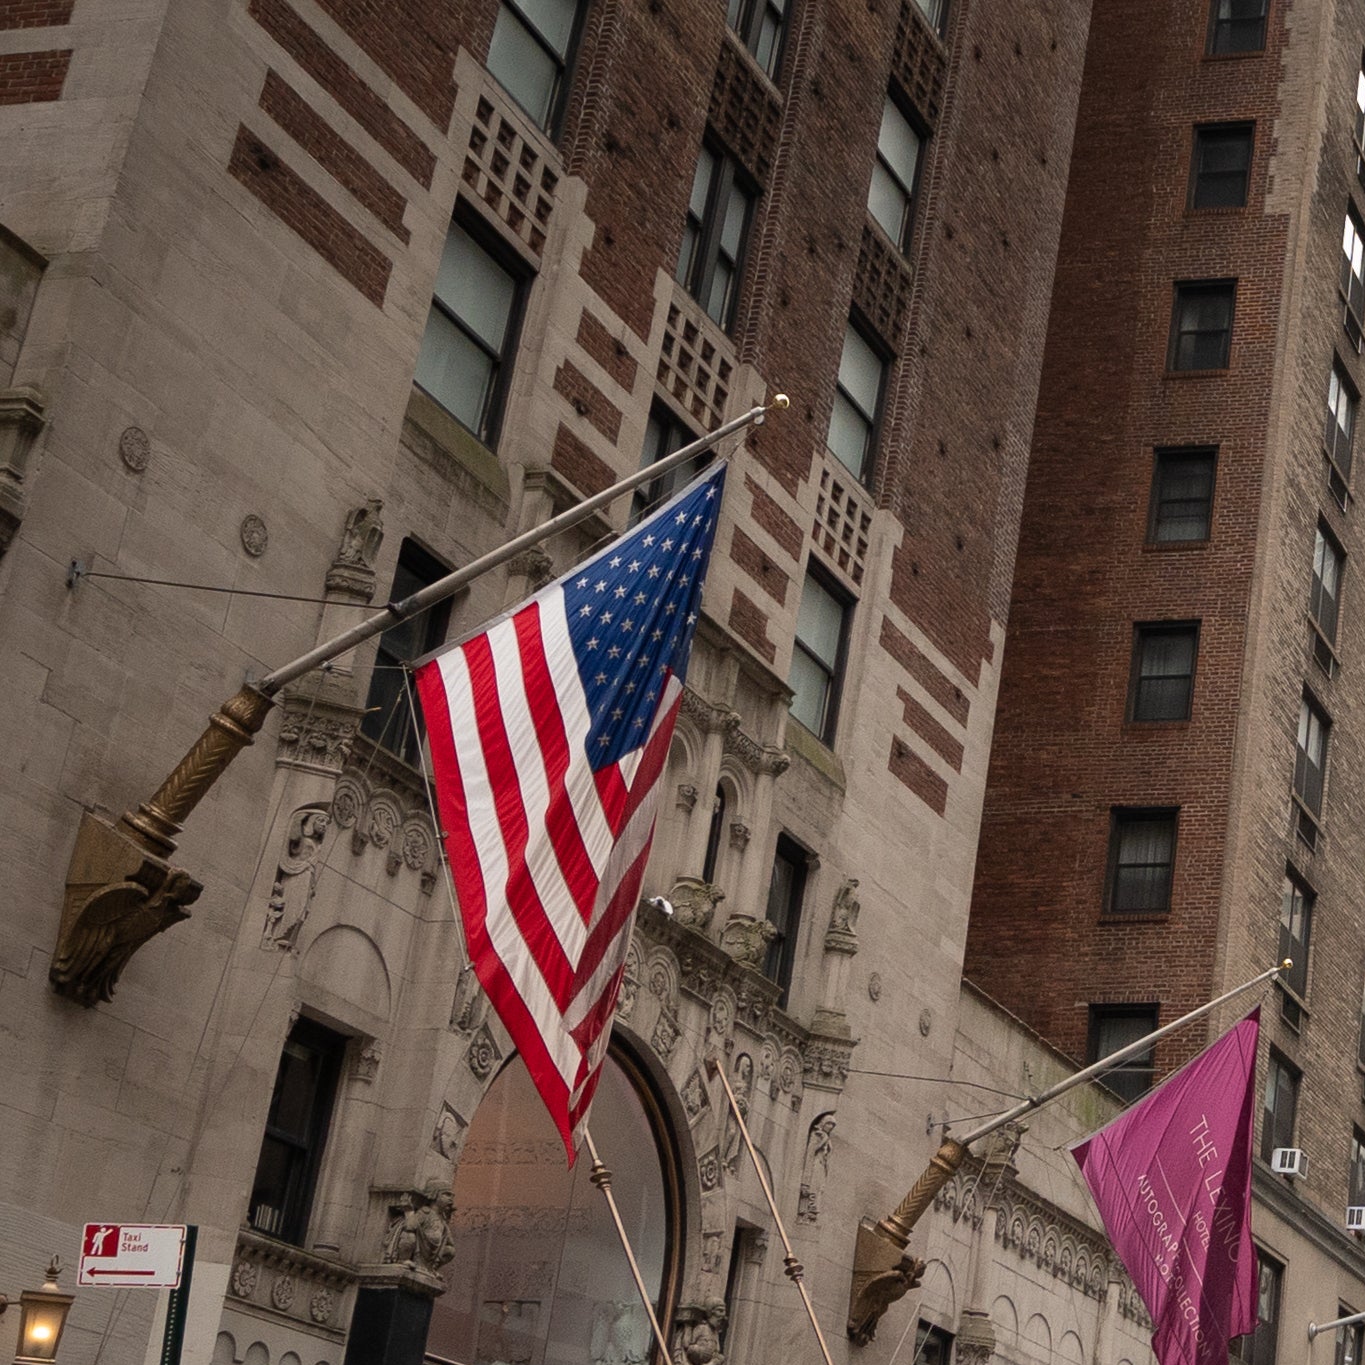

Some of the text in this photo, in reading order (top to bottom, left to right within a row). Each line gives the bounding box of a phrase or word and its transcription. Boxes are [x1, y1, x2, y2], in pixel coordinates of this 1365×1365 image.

[1189, 1113, 1219, 1169] THE
[123, 1232, 142, 1242] Taxi
[121, 1243, 149, 1252] Stand
